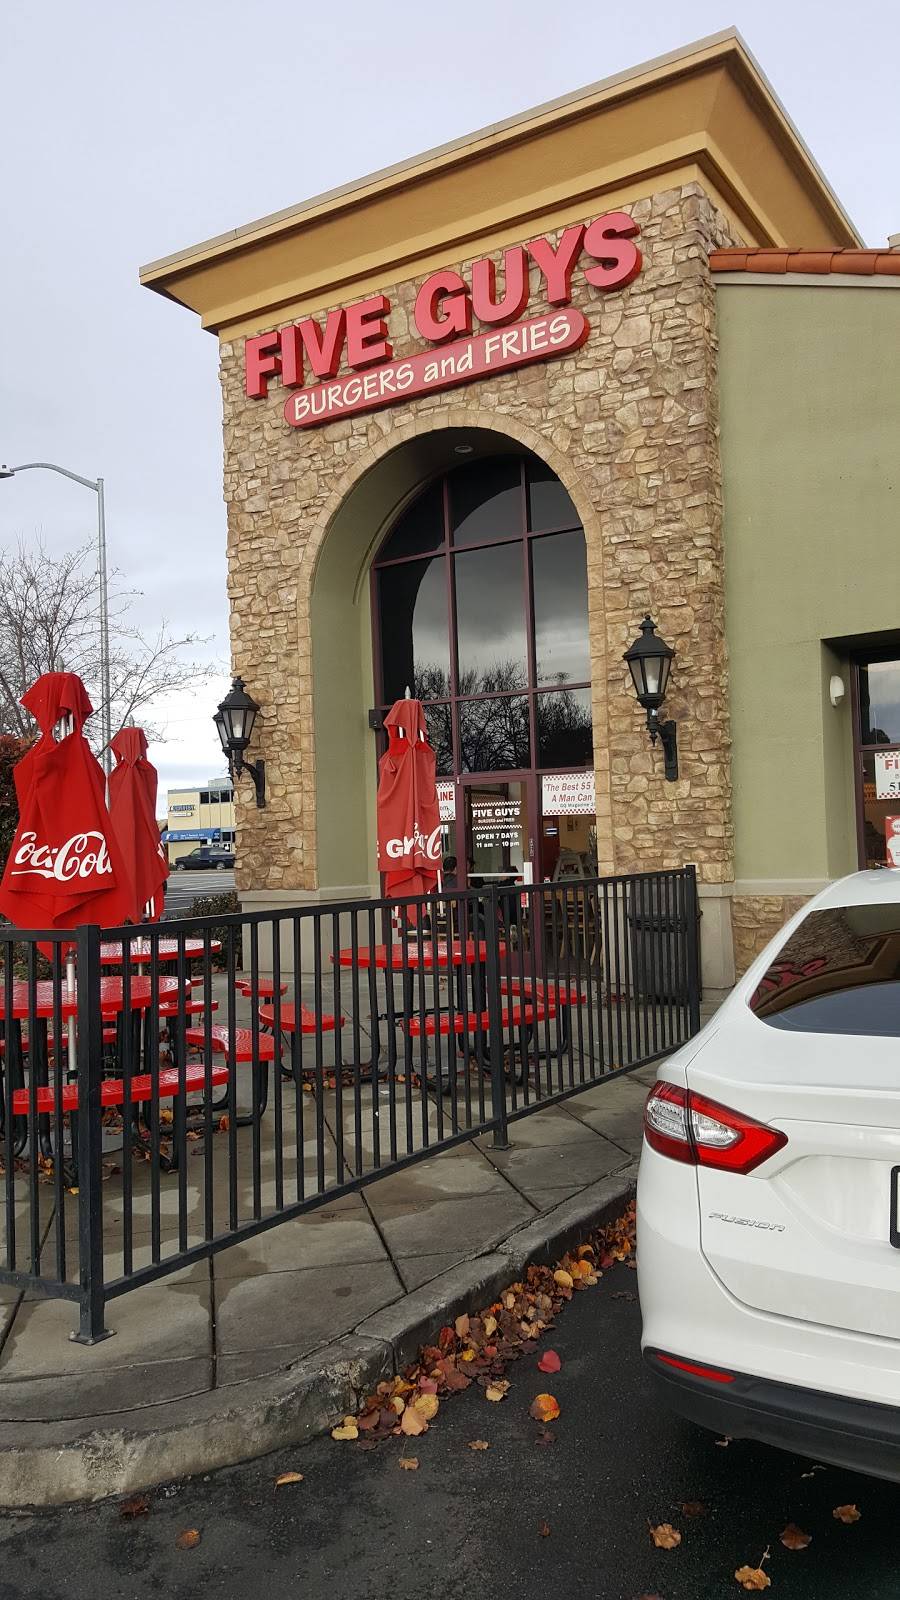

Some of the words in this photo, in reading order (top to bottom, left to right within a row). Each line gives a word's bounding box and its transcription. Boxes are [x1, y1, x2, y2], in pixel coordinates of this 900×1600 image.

[245, 294, 392, 399] FIVE
[414, 211, 642, 344] GUYS
[294, 363, 414, 421] BURGERS
[423, 344, 473, 383] and
[485, 314, 571, 364] FRIES
[561, 782, 579, 791] Best
[552, 794, 557, 803] A
[559, 794, 576, 802] Man
[577, 793, 593, 802] Can
[472, 809, 493, 818] FIVE
[494, 808, 520, 816] GUYS
[708, 1212, 786, 1232] FUSION
